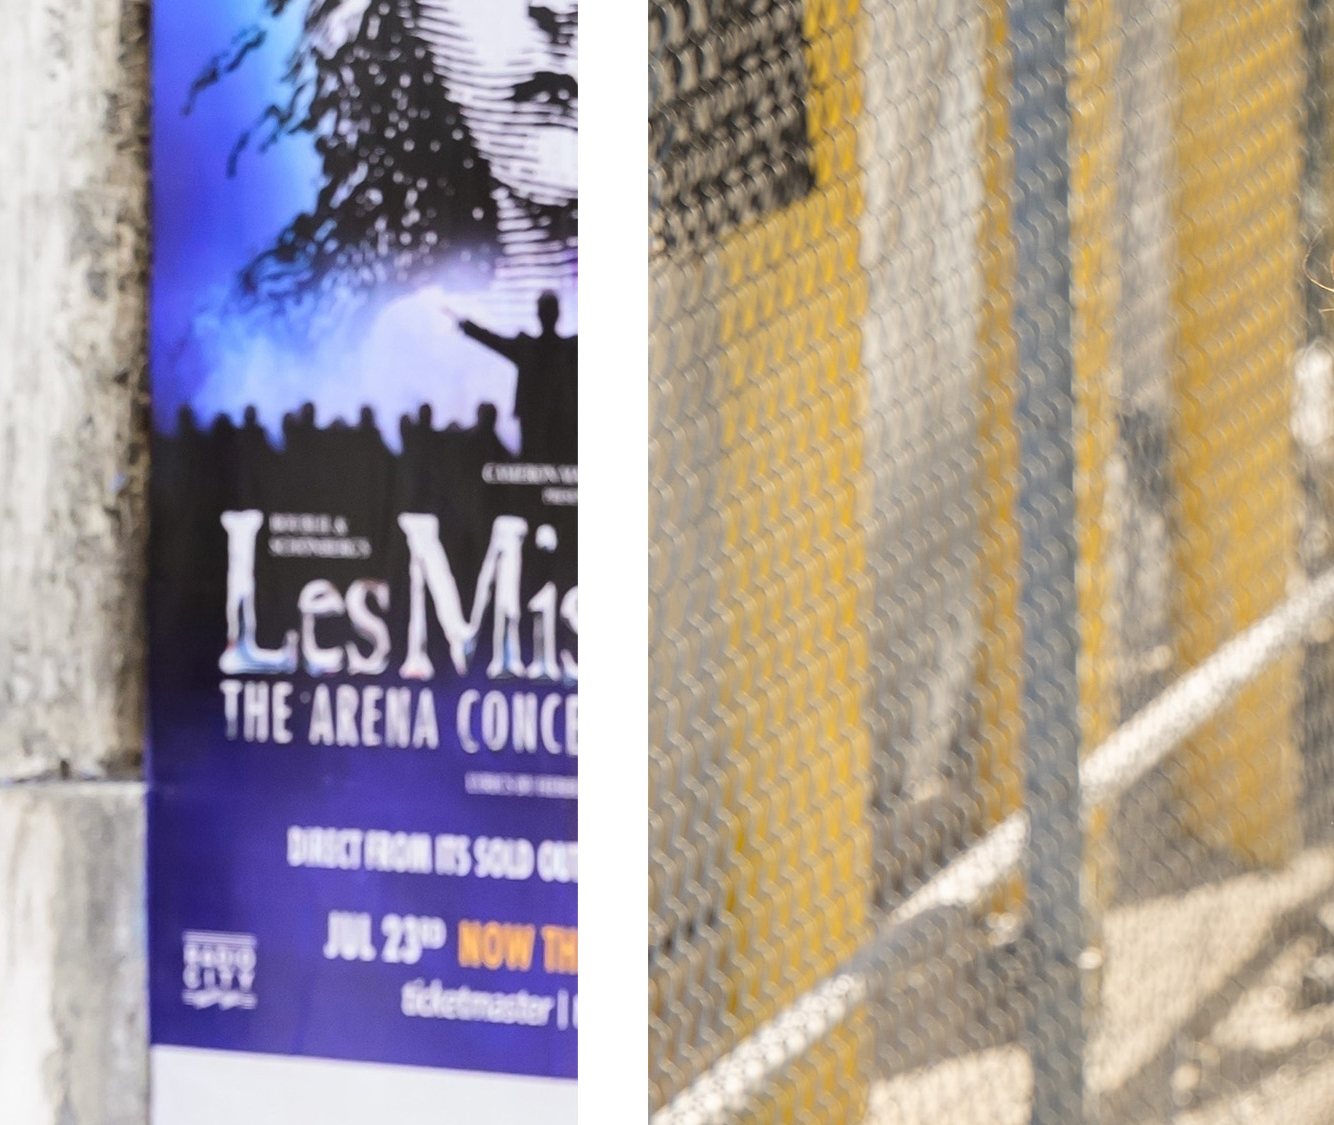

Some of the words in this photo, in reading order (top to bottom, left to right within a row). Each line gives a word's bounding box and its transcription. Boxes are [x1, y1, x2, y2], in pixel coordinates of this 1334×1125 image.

[219, 509, 391, 676] Les
[219, 680, 294, 744] THE
[308, 683, 440, 750] ARENA
[287, 825, 364, 870] DIRECT
[364, 829, 433, 874] FROM
[434, 833, 473, 877] ITS
[474, 836, 534, 880] SOLD
[323, 909, 377, 962] JUL
[458, 918, 537, 972] NOW
[401, 977, 555, 1027] ticketmaster
